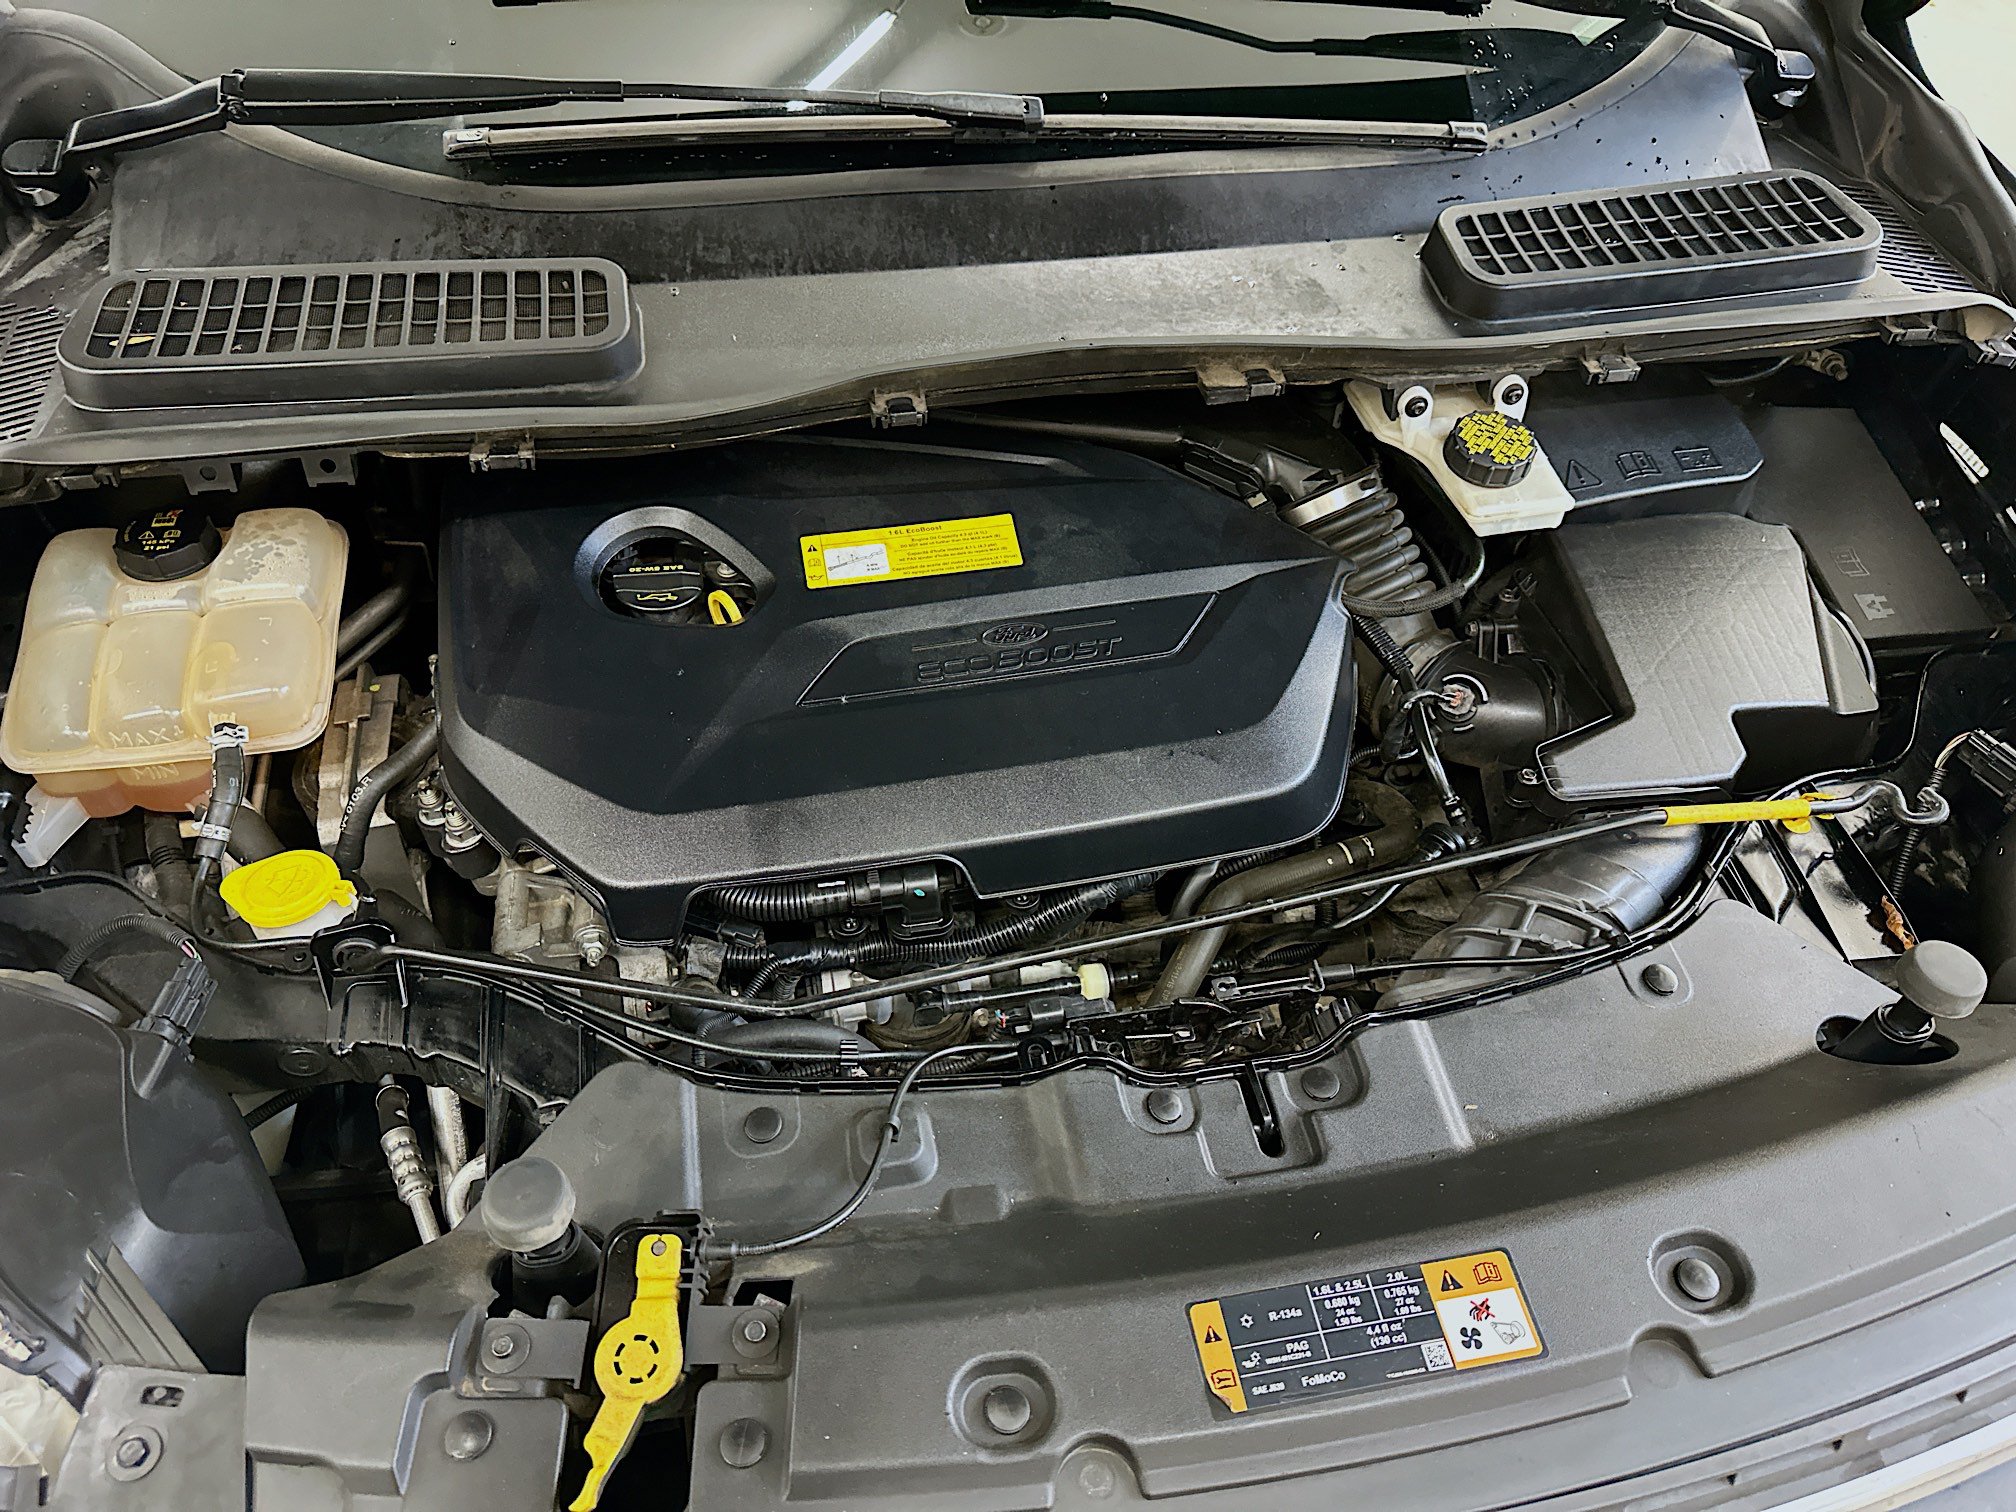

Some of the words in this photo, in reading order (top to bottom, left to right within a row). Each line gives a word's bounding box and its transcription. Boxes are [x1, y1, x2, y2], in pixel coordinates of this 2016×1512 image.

[906, 526, 942, 534] EcoBoost
[917, 636, 1123, 683] ECOBOOST
[131, 763, 180, 781] MIN
[1387, 1271, 1408, 1283] 2.0L
[1313, 1284, 1334, 1296] 1.6L
[1335, 1283, 1344, 1291] &
[1344, 1279, 1366, 1290] 2.5L
[1384, 1287, 1407, 1298] 0.765
[1408, 1285, 1420, 1296] kg
[1348, 1296, 1361, 1306] kg
[1268, 1308, 1303, 1321] R-134a
[1335, 1309, 1345, 1317] 24
[1391, 1323, 1402, 1331] oz
[1286, 1340, 1309, 1353] PAG
[1370, 1336, 1390, 1348] (130
[1392, 1332, 1407, 1343] cc)
[1301, 1370, 1346, 1387] FoMoCo
[1252, 1386, 1268, 1395] SAE
